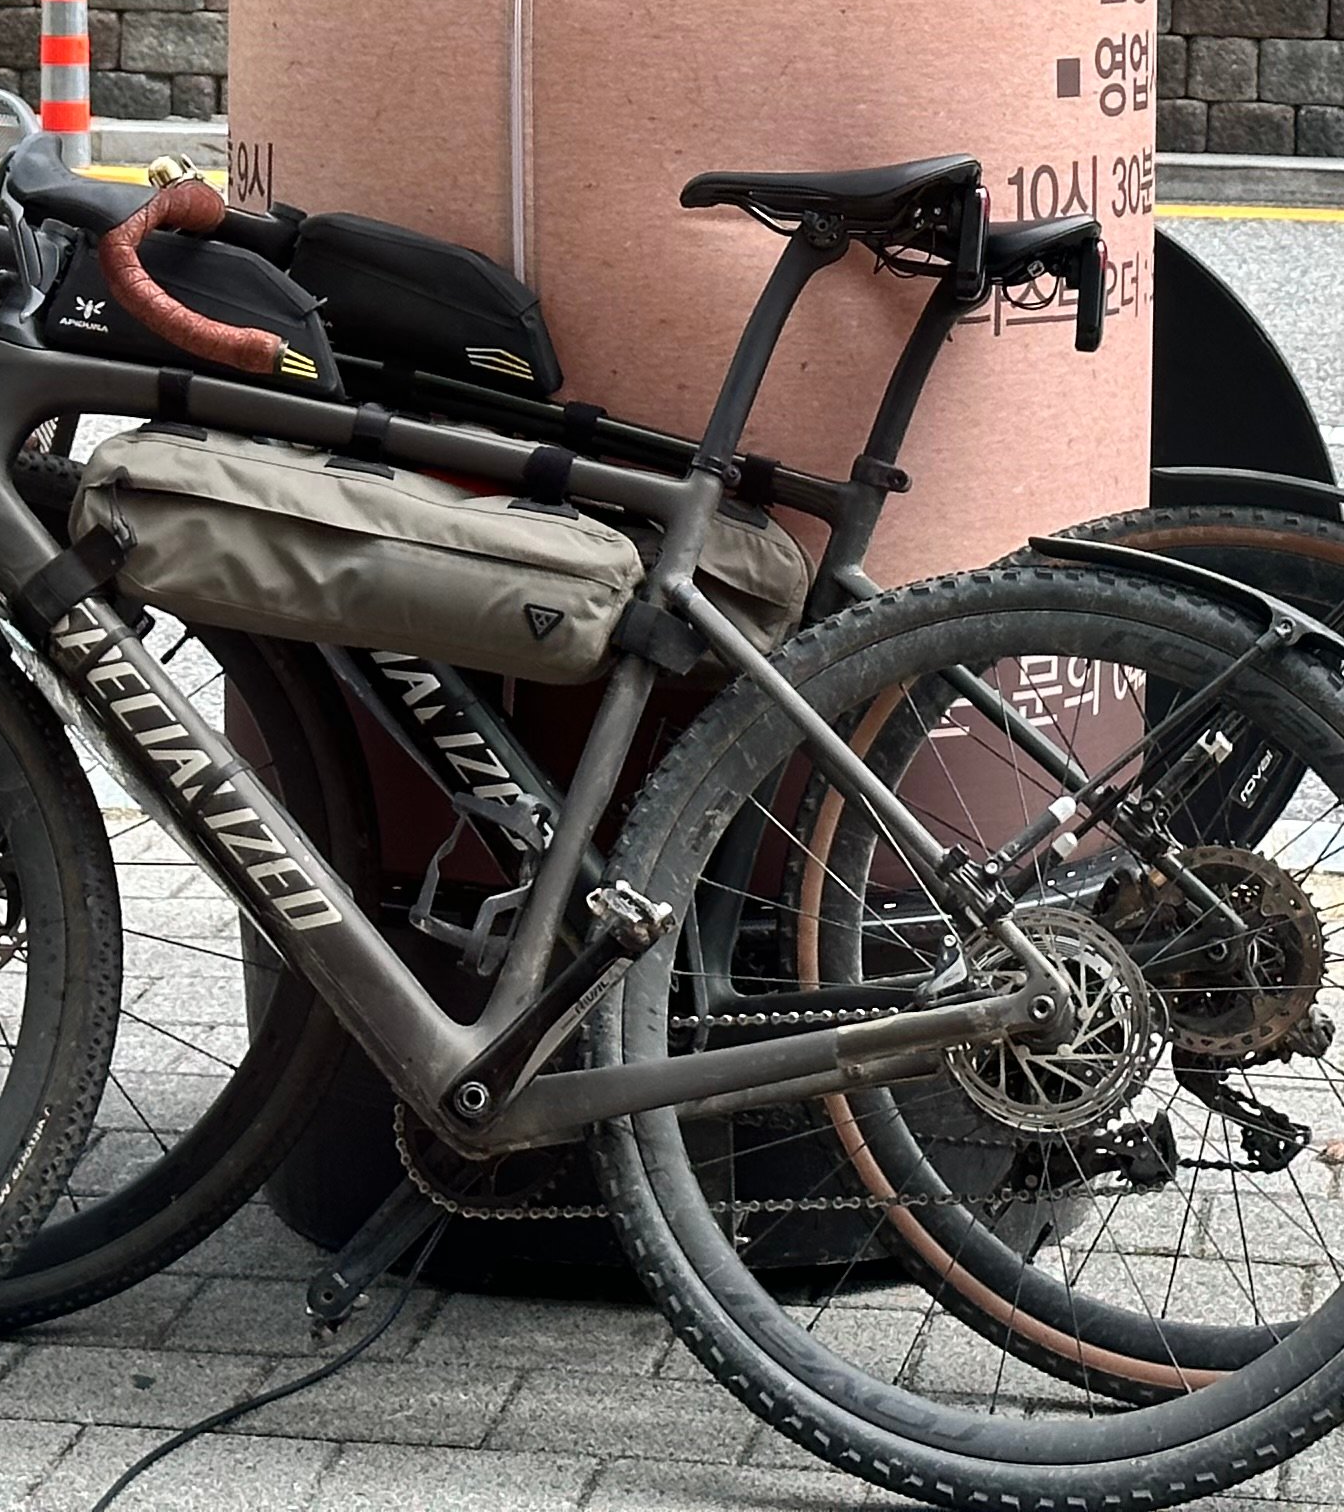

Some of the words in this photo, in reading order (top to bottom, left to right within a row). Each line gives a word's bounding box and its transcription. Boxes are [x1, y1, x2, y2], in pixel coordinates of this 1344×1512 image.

[1094, 29, 1155, 118] 영업
[1007, 155, 1098, 222] 10시
[1111, 143, 1154, 218] 30분
[1011, 654, 1101, 727] 문의
